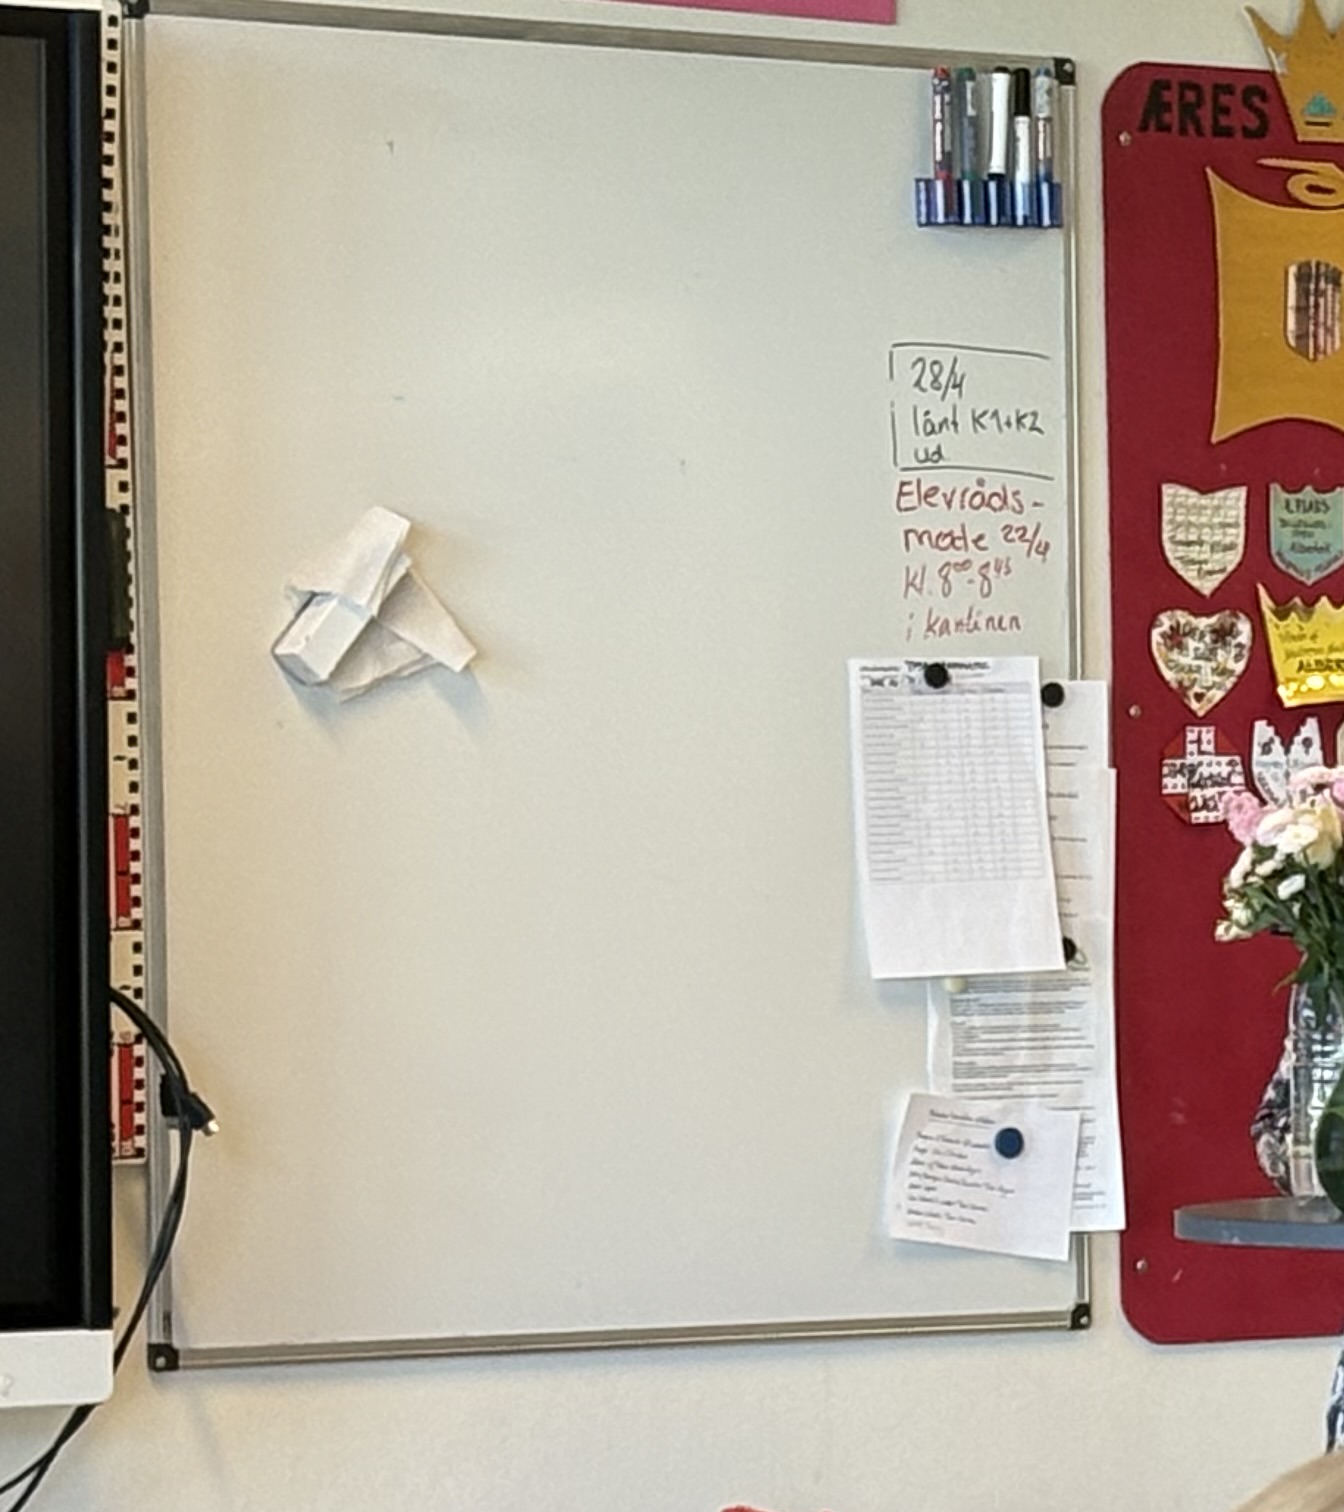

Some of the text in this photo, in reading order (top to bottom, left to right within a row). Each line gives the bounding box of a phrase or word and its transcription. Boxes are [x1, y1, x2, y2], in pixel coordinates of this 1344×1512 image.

[1137, 78, 1270, 140] ÆRES
[911, 355, 967, 402] 28/4
[913, 443, 944, 464] ud
[1001, 522, 1051, 563] 22/4
